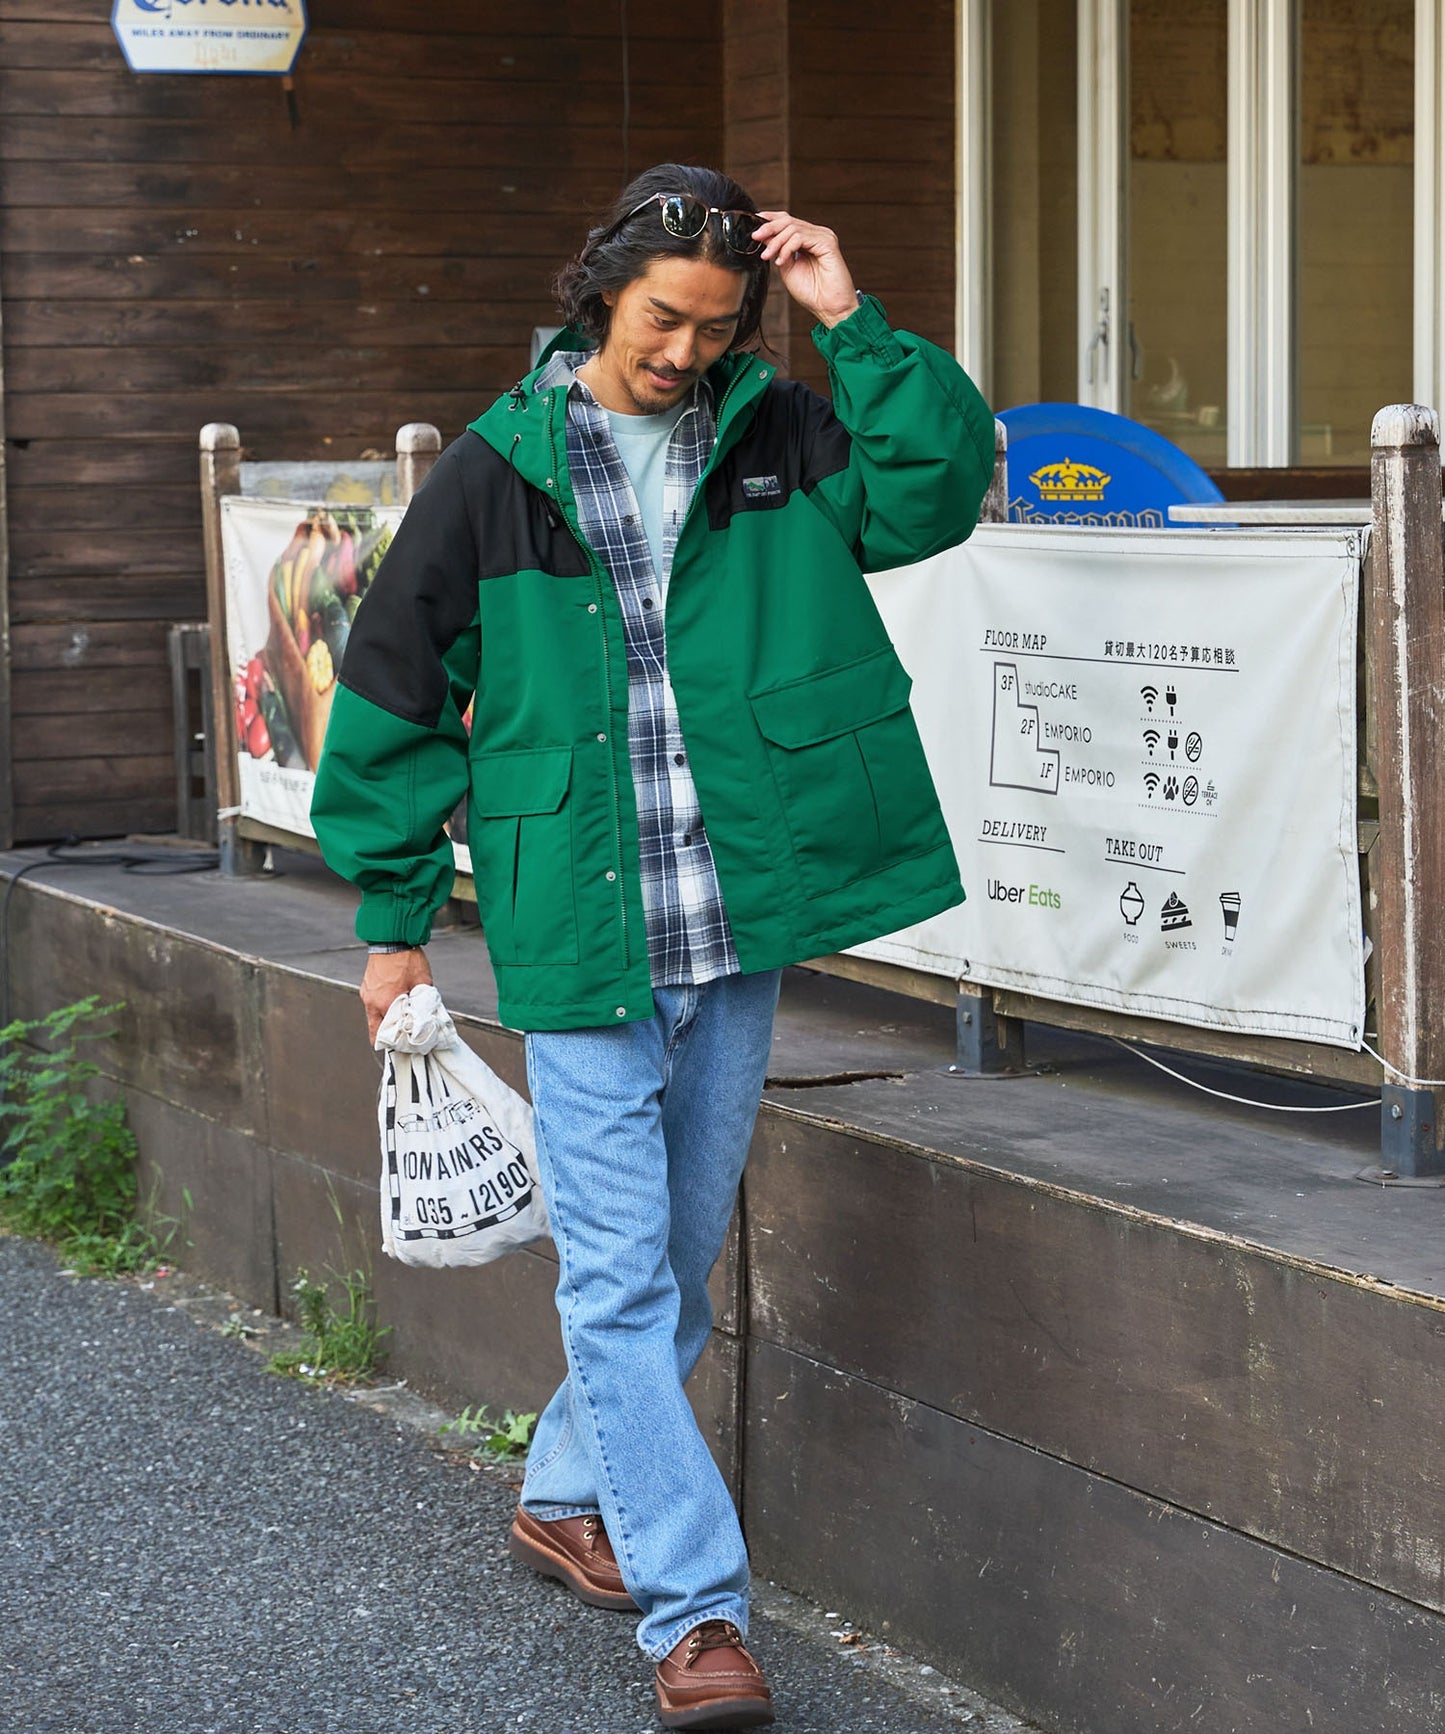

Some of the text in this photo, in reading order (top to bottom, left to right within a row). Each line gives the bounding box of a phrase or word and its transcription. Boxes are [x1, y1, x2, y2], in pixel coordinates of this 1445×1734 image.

[985, 629, 1047, 650] FLOOR MAP
[1104, 640, 1236, 665] 貸切最大120名予算応相談
[1001, 675, 1078, 700] 3F studioCAKE
[1020, 719, 1092, 744] 2F EMPORIO
[1040, 763, 1116, 788] 1F EMPORIO
[982, 819, 1047, 842] DELIVERY
[1106, 838, 1163, 862] TAKE OUT
[987, 878, 1062, 909] Uber Eats
[1164, 940, 1197, 951] SWEETS
[416, 1196, 453, 1225] 035
